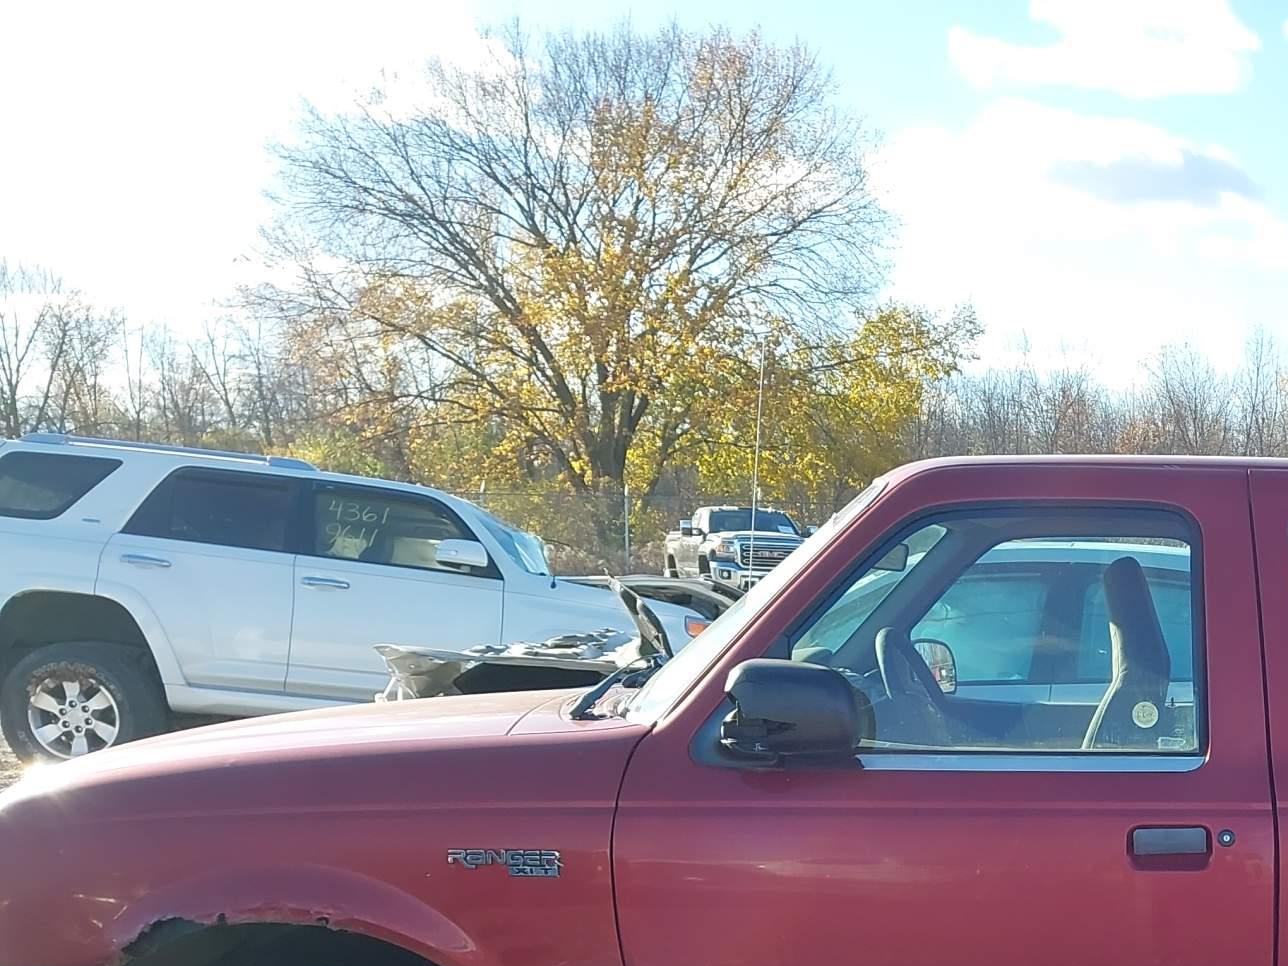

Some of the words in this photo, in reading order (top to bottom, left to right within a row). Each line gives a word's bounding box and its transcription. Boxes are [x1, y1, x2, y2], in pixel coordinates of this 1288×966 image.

[328, 500, 390, 524] 4361
[447, 849, 565, 869] RANGER
[512, 866, 558, 877] XLT
